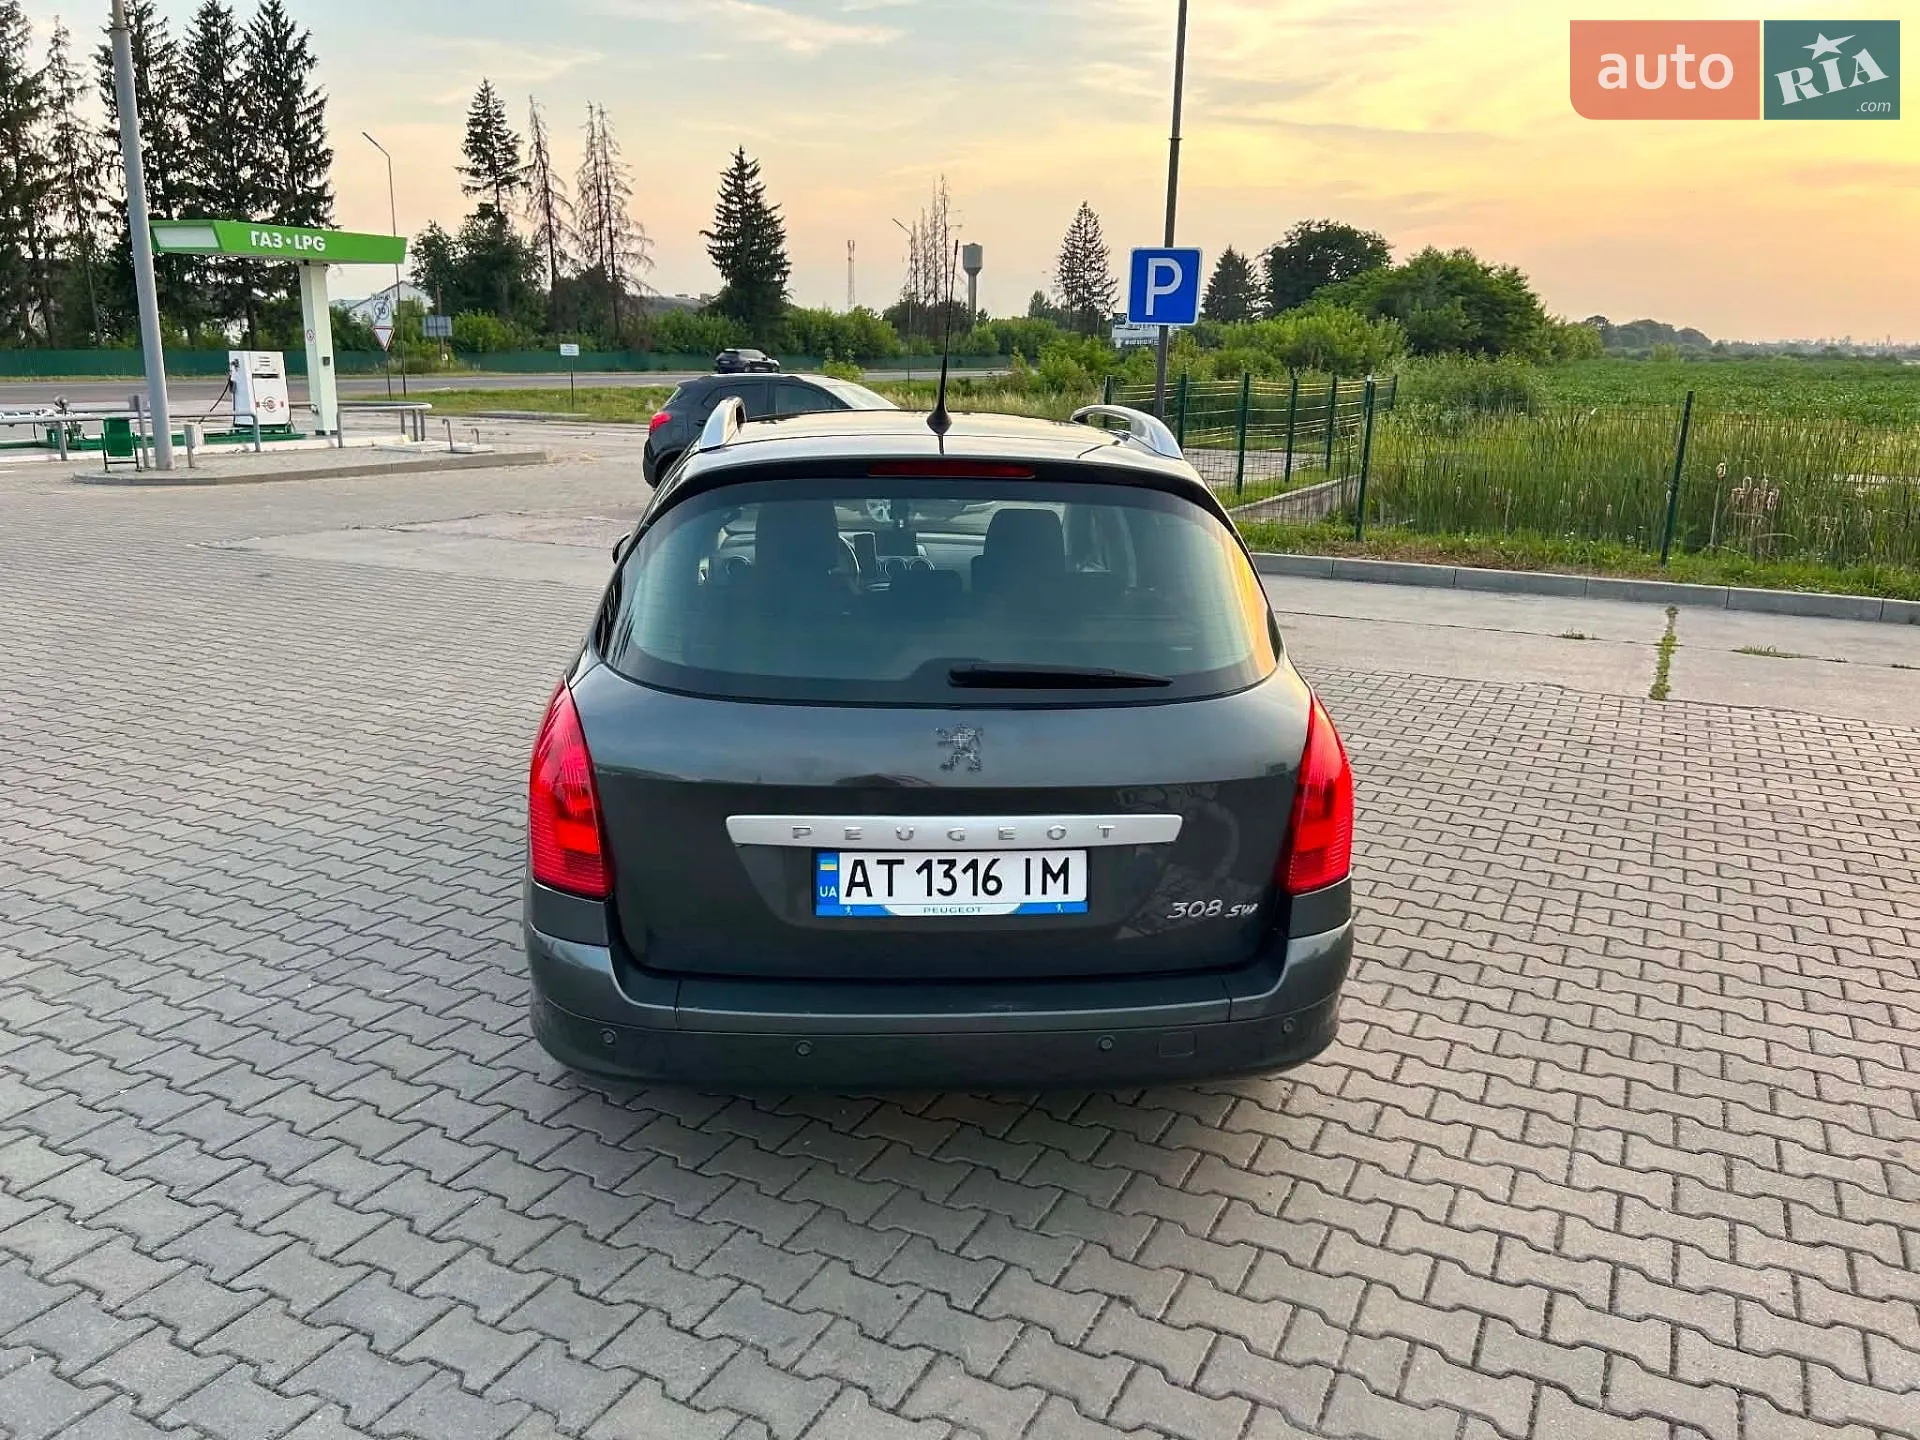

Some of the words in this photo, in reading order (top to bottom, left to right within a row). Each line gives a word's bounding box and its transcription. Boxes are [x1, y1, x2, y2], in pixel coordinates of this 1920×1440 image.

[250, 230, 283, 249] ГАЗ
[294, 234, 326, 252] LPG
[1145, 257, 1183, 316] P
[792, 824, 1116, 841] PEUGEOT
[845, 858, 905, 898] AT
[915, 857, 1003, 897] 1316
[1024, 856, 1070, 896] IM
[819, 886, 838, 898] UA
[923, 906, 983, 914] PEUGEOT
[1166, 899, 1224, 919] 308
